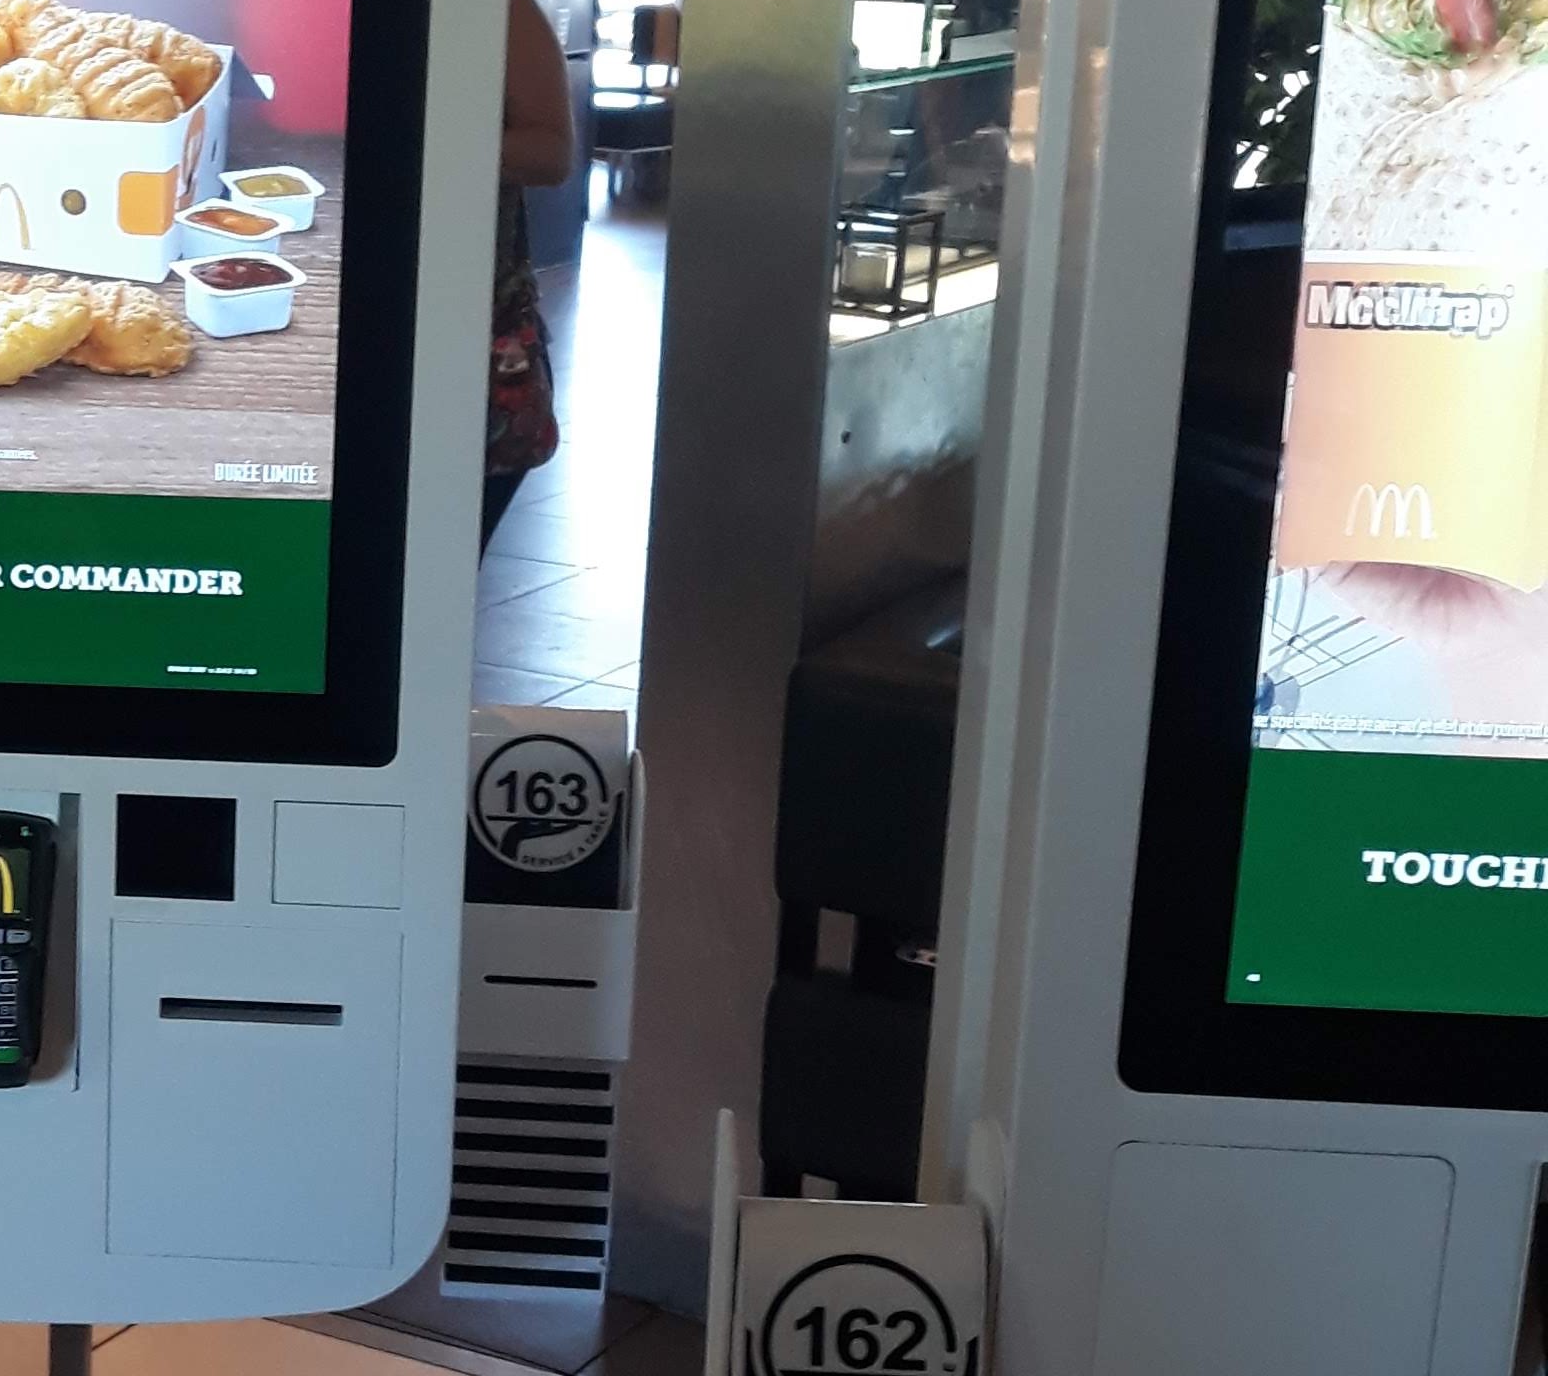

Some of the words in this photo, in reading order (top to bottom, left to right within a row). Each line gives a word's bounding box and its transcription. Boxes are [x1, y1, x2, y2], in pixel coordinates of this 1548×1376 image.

[10, 564, 243, 596] COMMANDER
[497, 770, 587, 816] 163
[1361, 850, 1548, 889] TOUCH
[795, 1306, 928, 1370] 162
